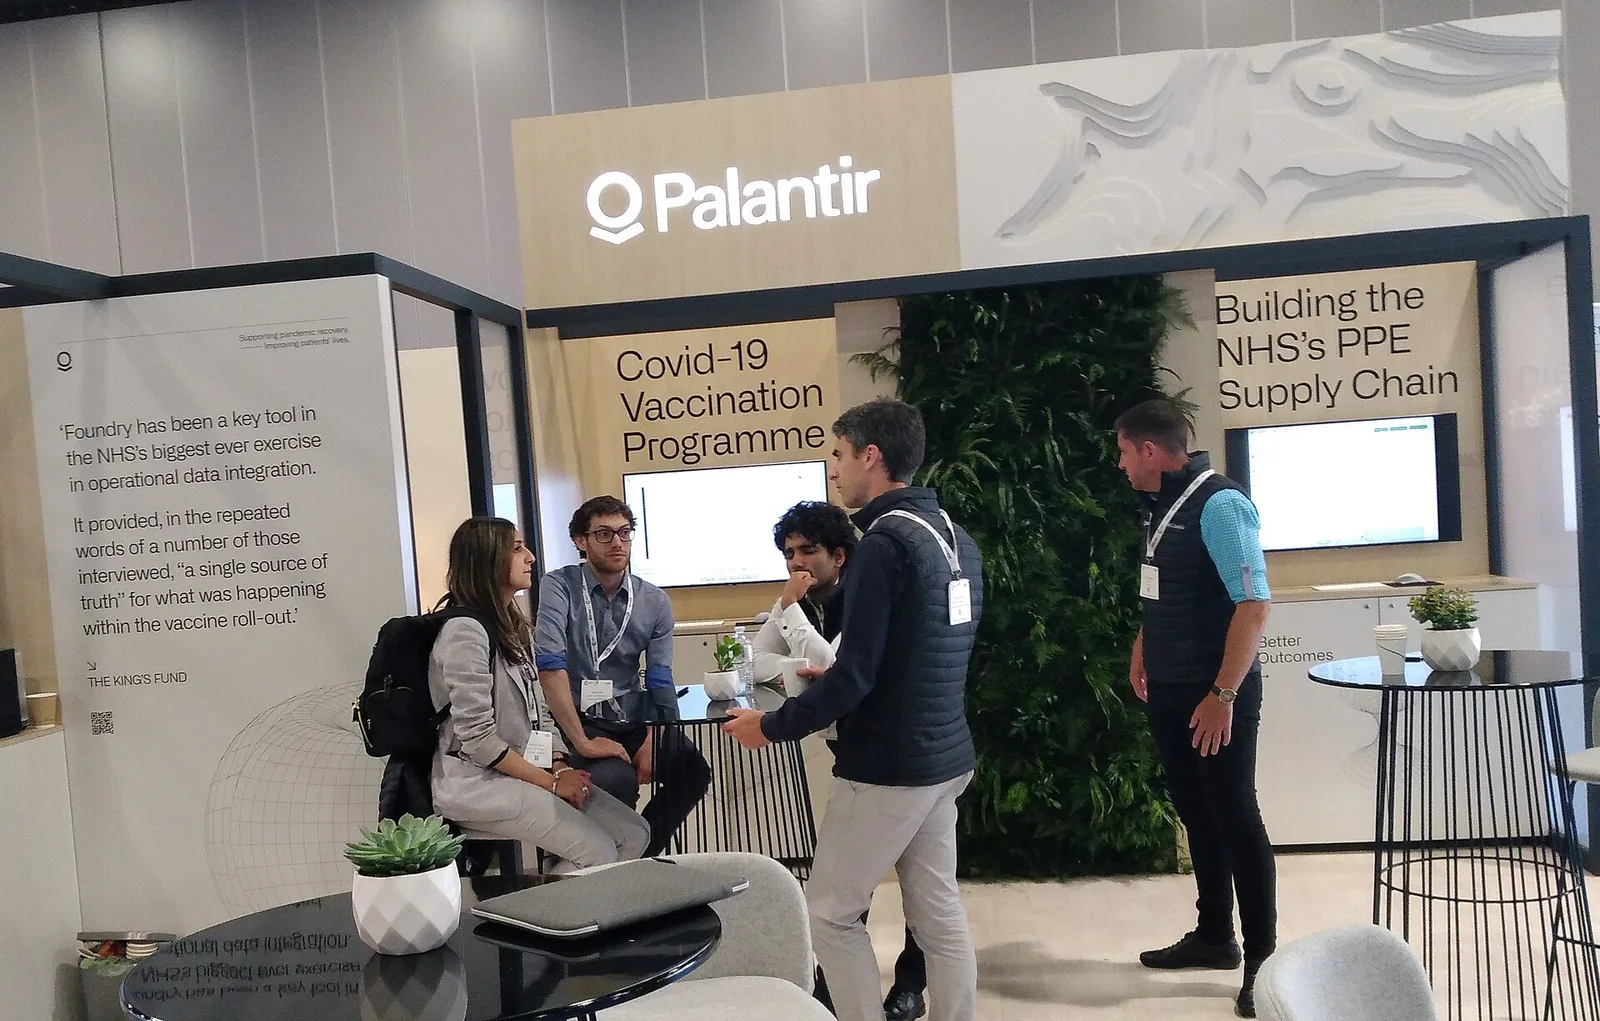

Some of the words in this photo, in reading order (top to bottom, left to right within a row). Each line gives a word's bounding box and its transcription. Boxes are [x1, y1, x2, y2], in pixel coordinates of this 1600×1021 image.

[654, 155, 880, 232] Palantir
[1215, 288, 1357, 325] Building
[1366, 282, 1424, 313] the
[239, 332, 278, 343] Supporting
[280, 329, 315, 341] pandemic
[317, 326, 348, 336] recovery.
[264, 341, 299, 350] Improving
[1218, 332, 1326, 367] NHS’s
[1338, 324, 1411, 358] PPE
[617, 338, 768, 381] Covid-19
[620, 380, 823, 423] Vaccination
[1219, 373, 1342, 413] Supply
[1352, 365, 1459, 400] Chain
[137, 418, 166, 435] has
[171, 415, 213, 432] been
[218, 415, 228, 428] a
[232, 411, 261, 430] key
[265, 407, 296, 425] tool
[301, 406, 316, 422] in
[66, 450, 93, 466] the
[97, 445, 148, 464] NHS’s
[152, 441, 210, 462] biggest
[214, 440, 249, 455] ever
[253, 433, 322, 452] exercise
[623, 424, 826, 465] Programme
[69, 476, 84, 493] in
[88, 469, 179, 492] operational
[183, 467, 221, 484] data
[225, 460, 317, 481] integration.
[74, 517, 83, 533] It
[88, 511, 163, 535] provided,
[166, 511, 181, 527] in
[185, 509, 212, 525] the
[216, 503, 290, 525] repeated
[75, 542, 125, 559] words
[128, 539, 145, 556] of
[149, 543, 160, 554] a
[164, 535, 228, 553] number
[232, 532, 249, 548] of
[253, 530, 300, 548] those
[78, 564, 175, 585] interviewed,
[199, 558, 246, 579] single
[250, 557, 307, 574] source
[311, 553, 328, 570] of
[81, 592, 125, 610] truth”
[129, 591, 151, 607] for
[155, 588, 195, 605] what
[199, 589, 232, 603] was
[236, 580, 326, 602] happening
[83, 619, 130, 636] within
[135, 617, 161, 632] the
[164, 612, 228, 631] vaccine
[1258, 650, 1333, 664] Outcomes
[1259, 635, 1301, 648] Better
[88, 676, 110, 688] THE
[113, 674, 152, 686] KING’S
[154, 672, 187, 684] FUND
